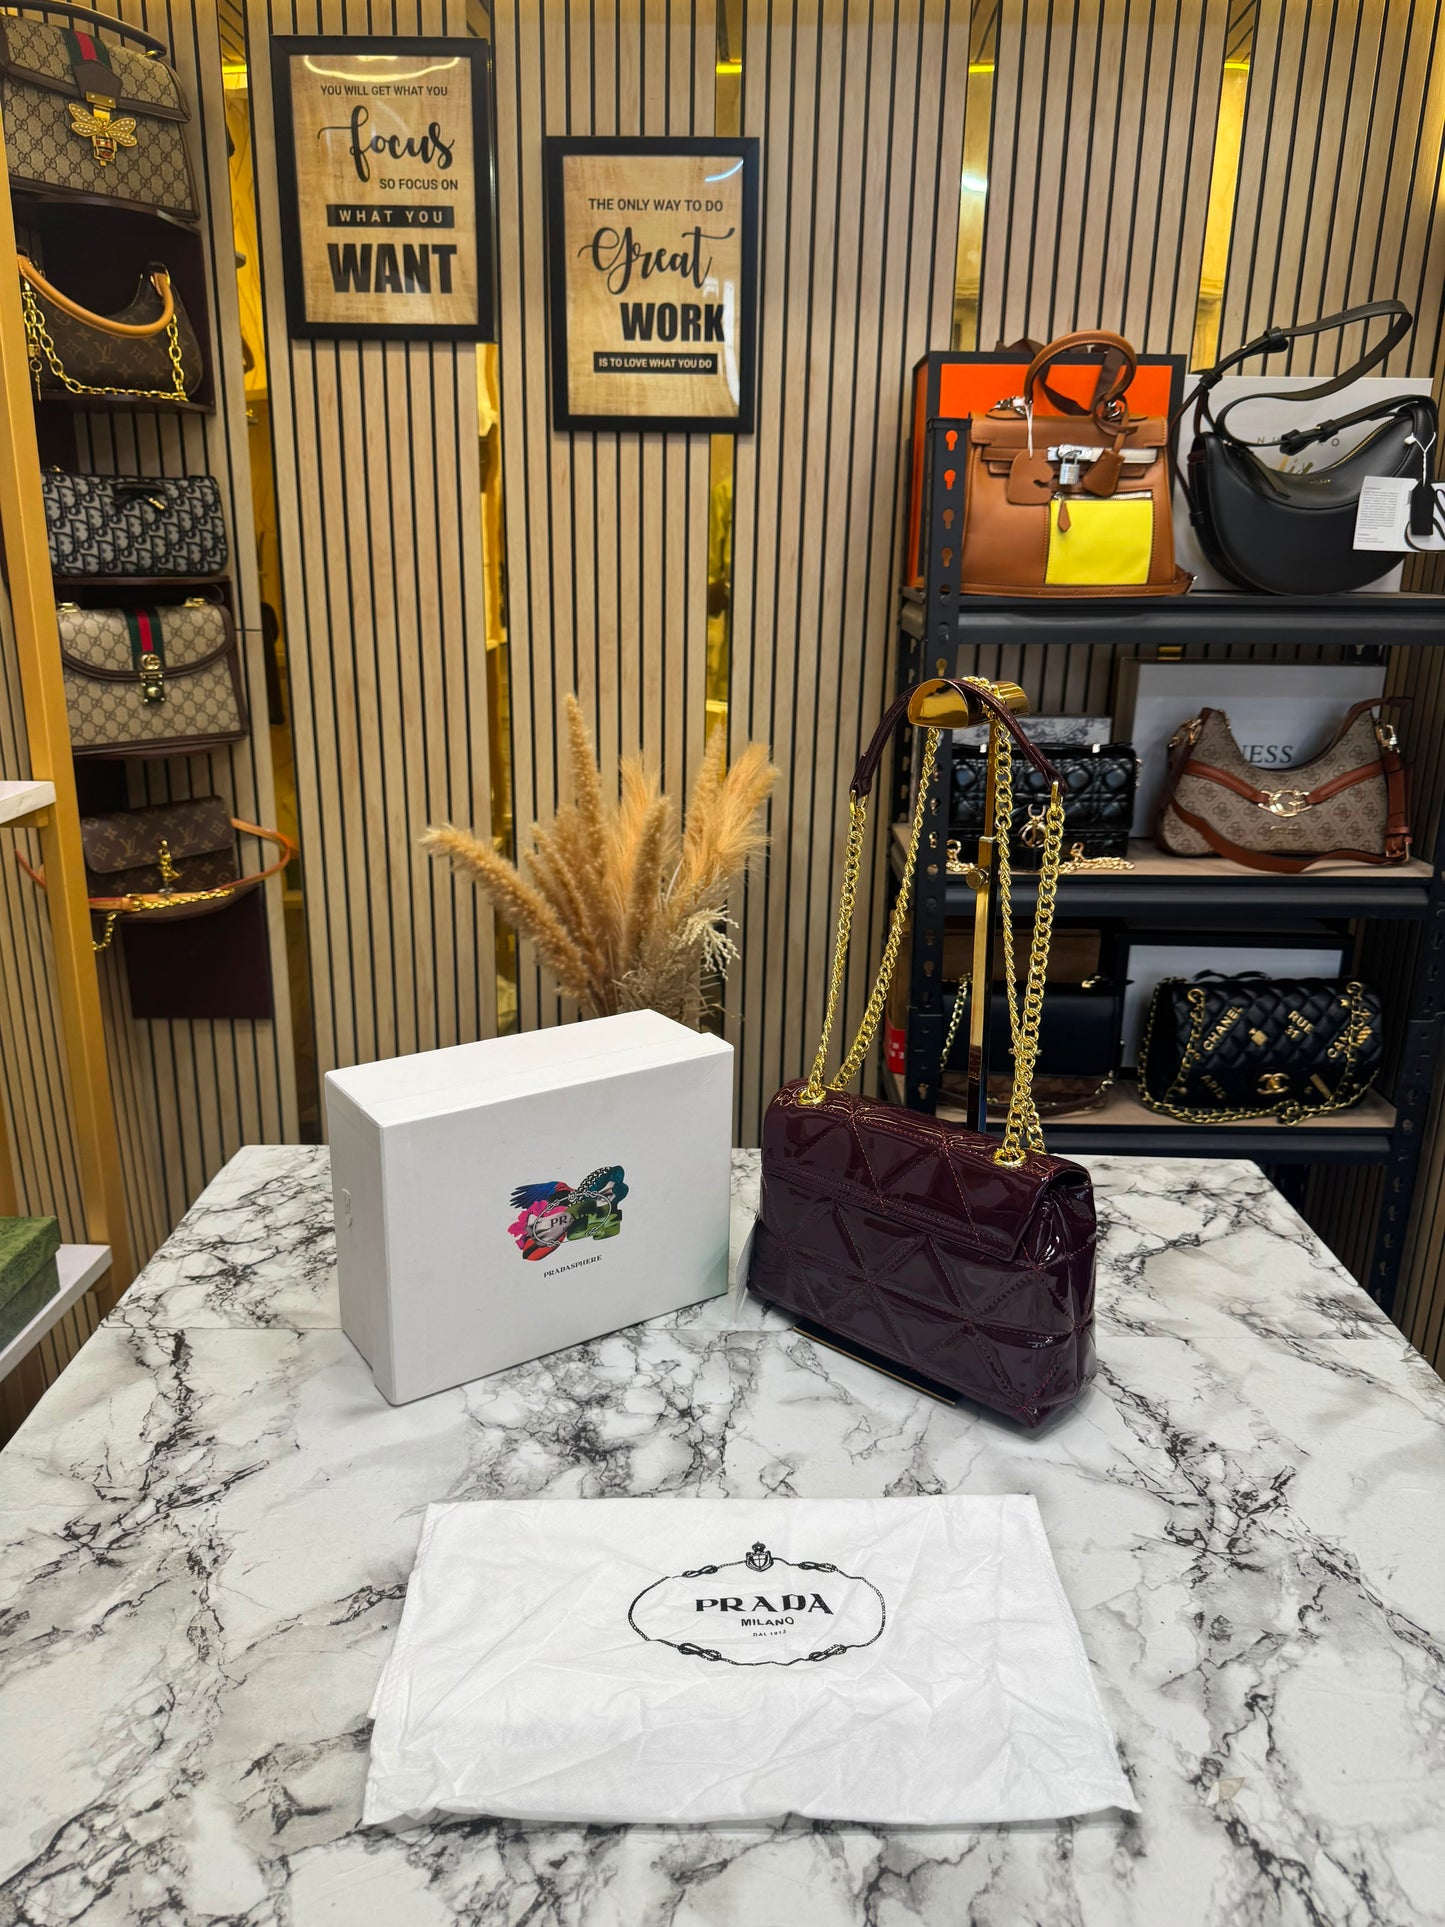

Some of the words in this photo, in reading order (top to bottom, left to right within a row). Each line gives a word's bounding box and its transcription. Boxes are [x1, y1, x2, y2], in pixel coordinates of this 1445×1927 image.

[320, 85, 342, 96] YOU
[344, 85, 368, 96] WILL
[371, 85, 392, 96] GET
[393, 86, 423, 96] WHAT
[426, 86, 448, 97] YOU
[317, 105, 455, 182] focus
[379, 178, 395, 190] SO
[399, 178, 438, 190] FOCUS
[441, 179, 459, 190] ON
[339, 209, 393, 222] WHAT
[406, 211, 443, 223] YOU
[588, 198, 614, 210] THE
[617, 198, 650, 211] ONLY
[653, 199, 681, 211] WAY
[684, 199, 702, 212] TO
[705, 200, 723, 212] DO
[327, 243, 457, 294] WANT
[577, 226, 736, 295] Great
[620, 302, 725, 342] WORK
[598, 358, 608, 367] IS
[610, 358, 622, 367] TO
[624, 358, 648, 368] LOVE
[649, 358, 676, 368] WHAT
[678, 359, 697, 369] YOU
[698, 359, 712, 369] DO
[1202, 1006, 1243, 1052] CHANEL
[1288, 1010, 1315, 1034] RUE
[543, 1254, 603, 1278] PRADASPHERE
[696, 1593, 834, 1615] PRADA
[741, 1616, 795, 1627] MILANO
